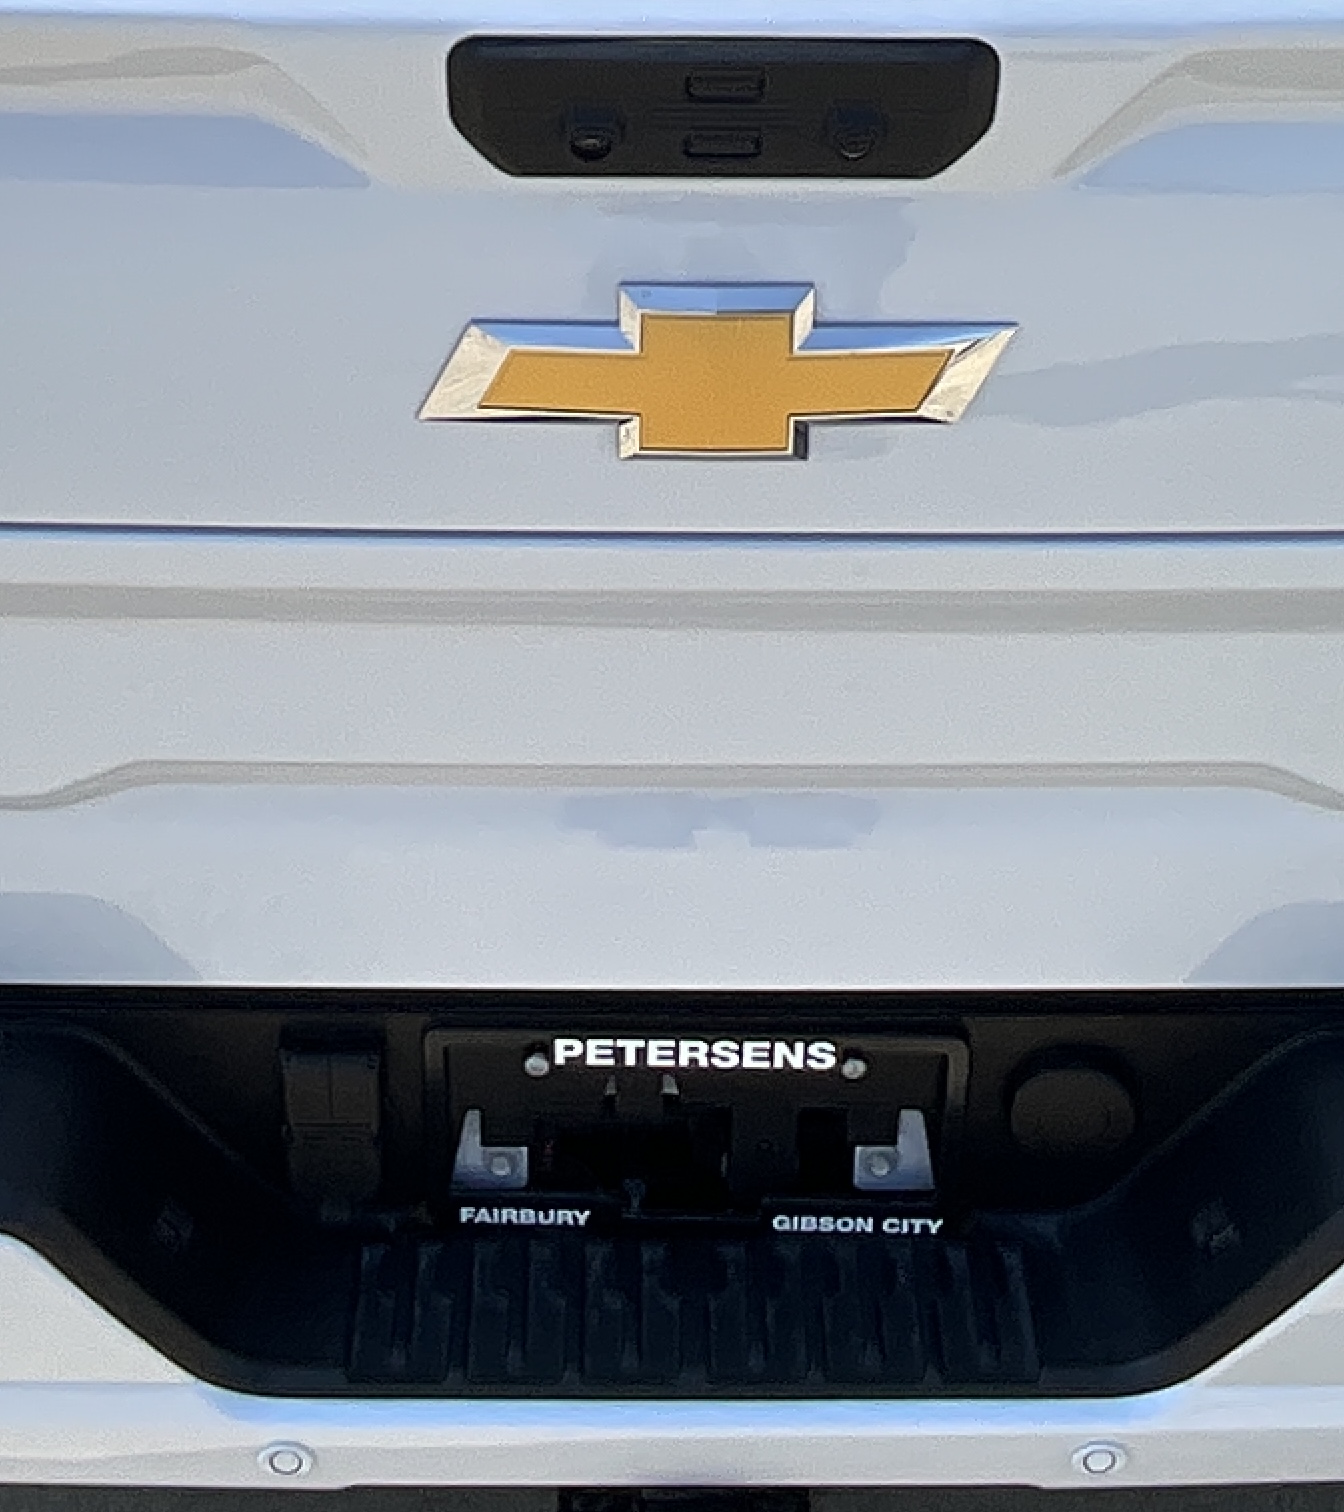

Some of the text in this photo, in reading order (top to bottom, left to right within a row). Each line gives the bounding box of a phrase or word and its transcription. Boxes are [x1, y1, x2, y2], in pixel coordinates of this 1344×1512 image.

[554, 1038, 838, 1070] PETERSENS
[459, 1206, 592, 1227] FAIRBURY
[771, 1213, 945, 1235] GIBSON CITY
